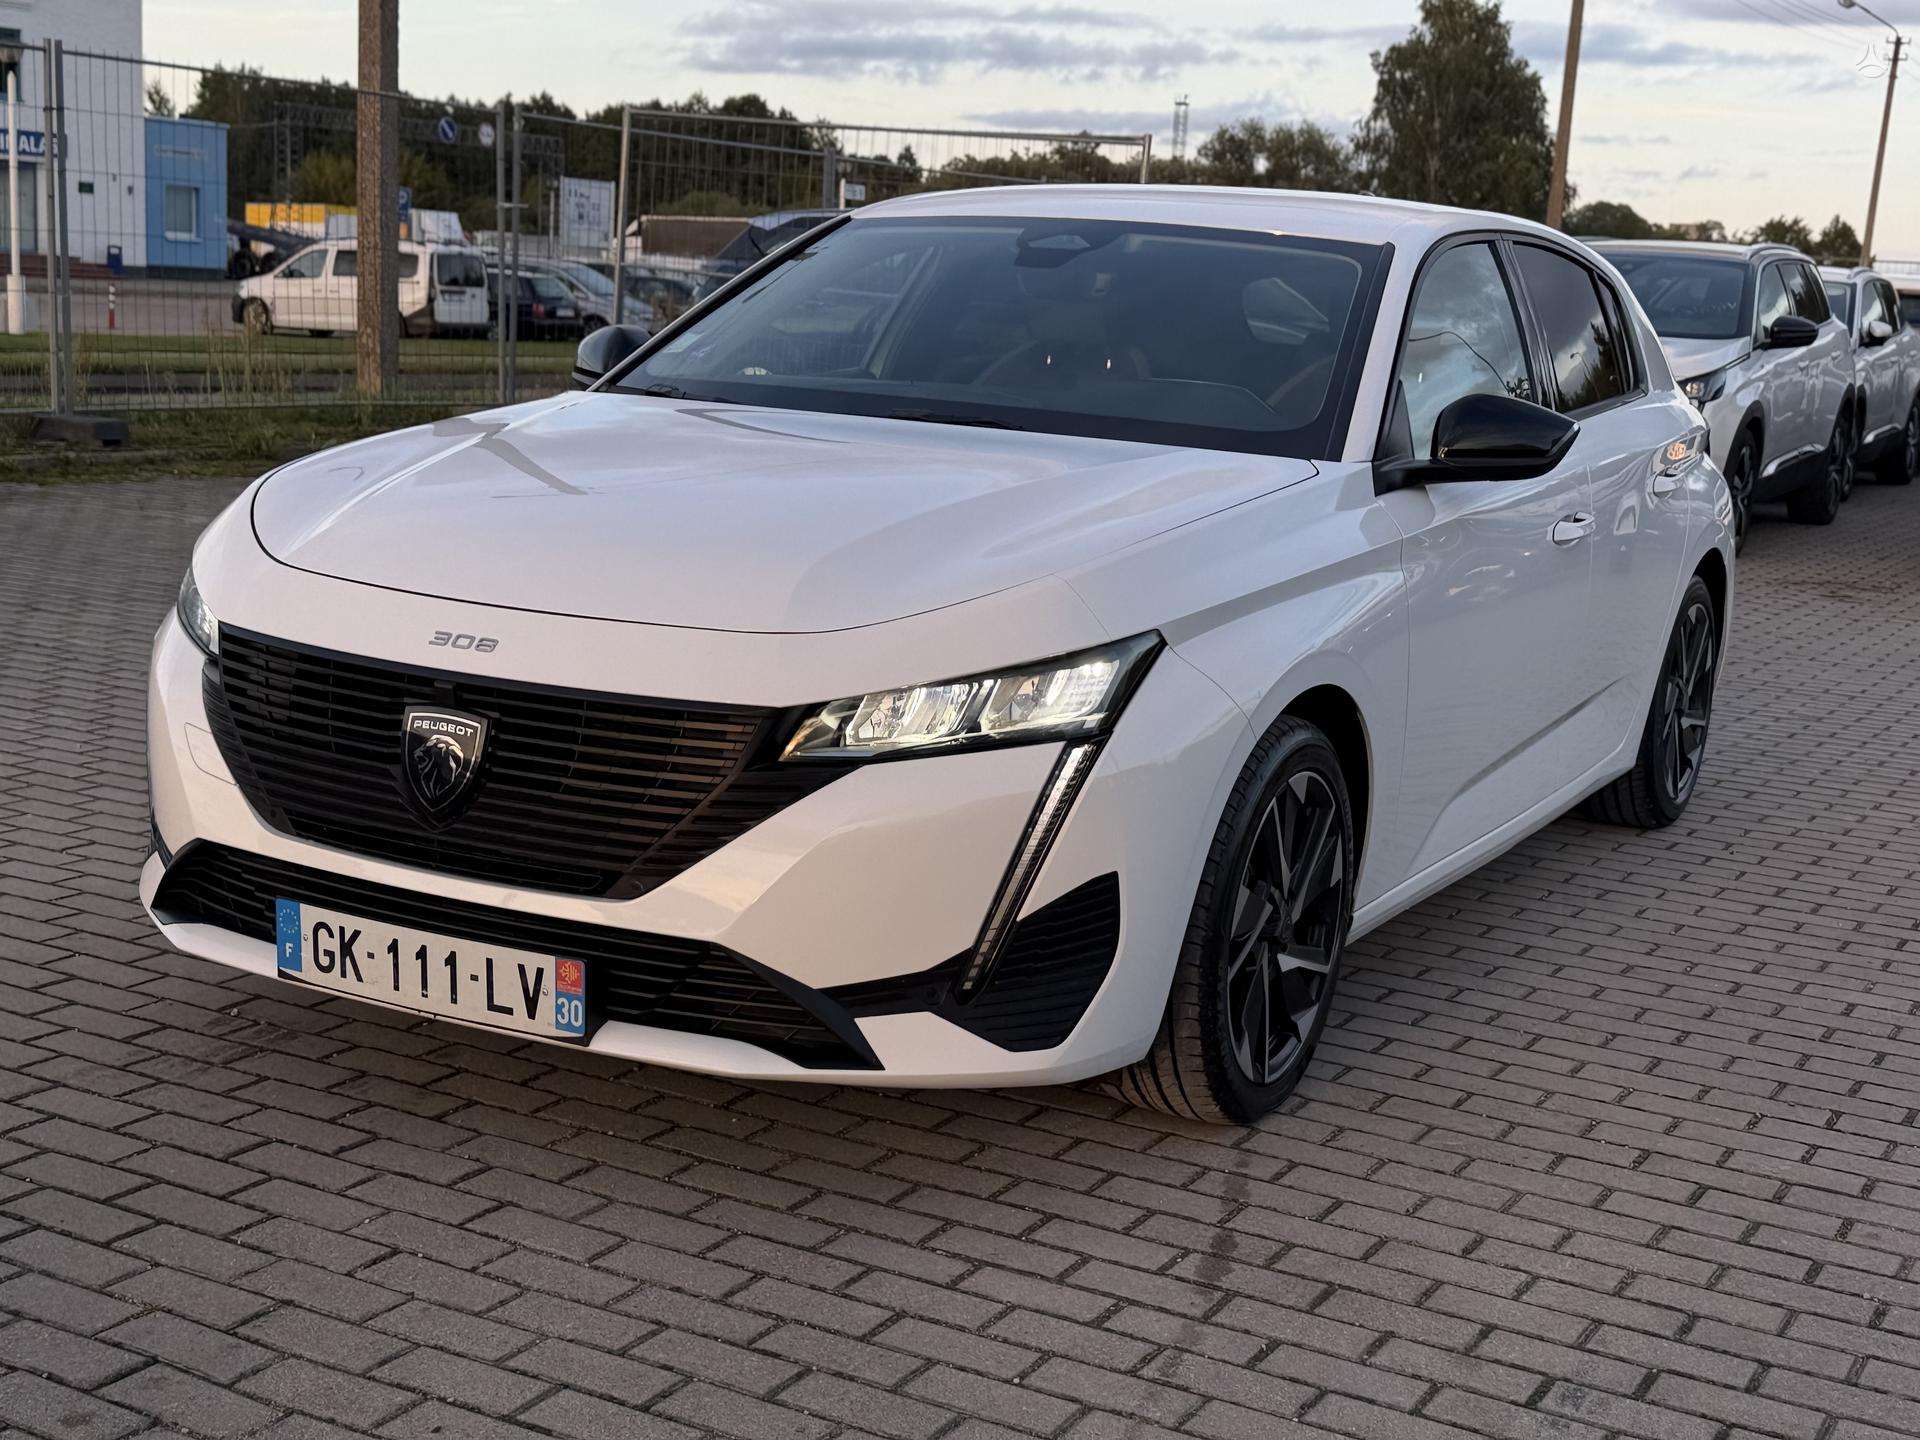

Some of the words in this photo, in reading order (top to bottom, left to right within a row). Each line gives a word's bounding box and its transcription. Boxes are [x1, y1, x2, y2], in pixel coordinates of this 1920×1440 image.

[429, 630, 499, 653] 308
[413, 720, 474, 737] PEUGEOT
[285, 942, 294, 958] F
[312, 921, 545, 1021] GK-111-LV
[556, 997, 583, 1028] 30
